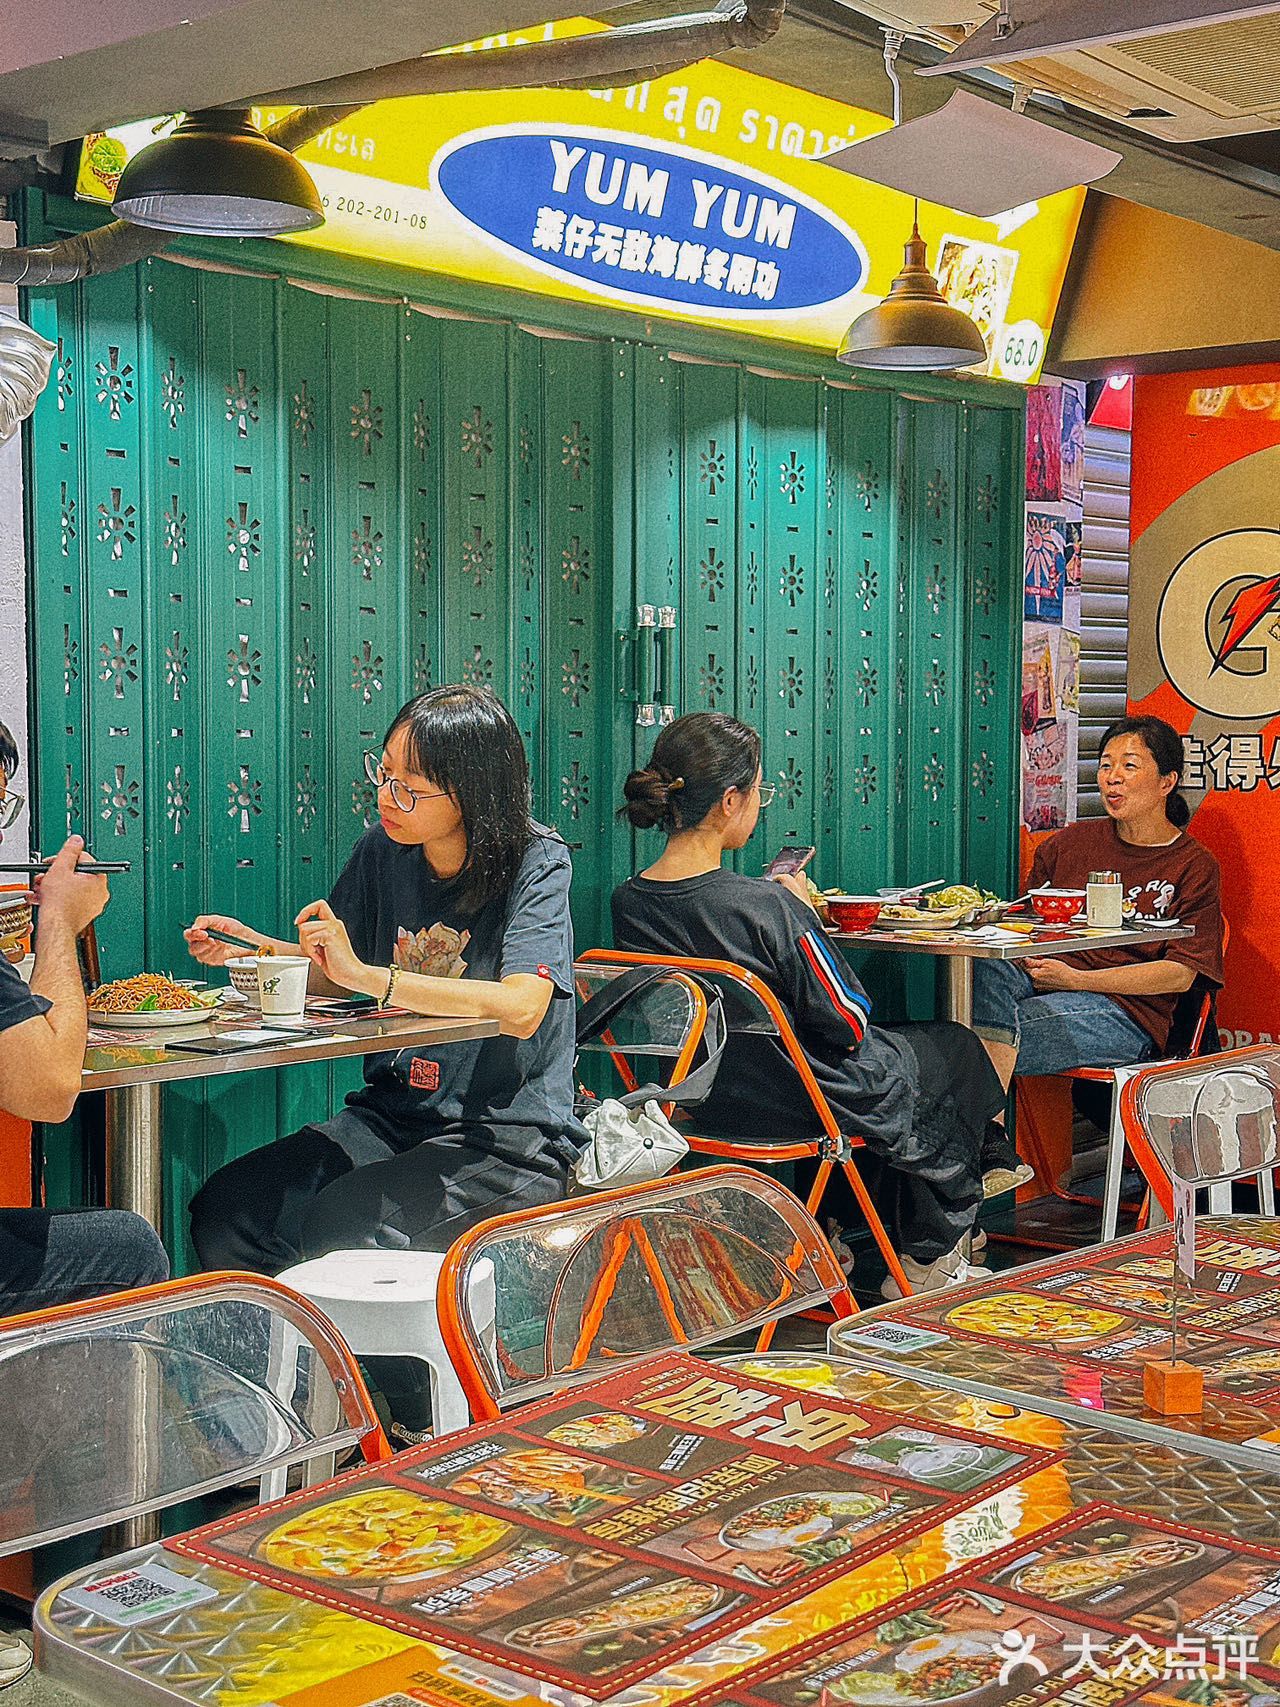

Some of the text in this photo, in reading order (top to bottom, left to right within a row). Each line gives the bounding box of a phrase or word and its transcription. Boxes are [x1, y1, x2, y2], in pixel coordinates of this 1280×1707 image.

[549, 139, 797, 250] YUM YUM
[336, 196, 428, 230] 202-201-08
[1004, 337, 1038, 366] 68.0
[582, 1453, 784, 1540] 阿莱招牌推荐
[717, 1484, 759, 1502] ZHAO
[658, 1514, 690, 1529] TUI
[688, 1501, 720, 1515] PAI
